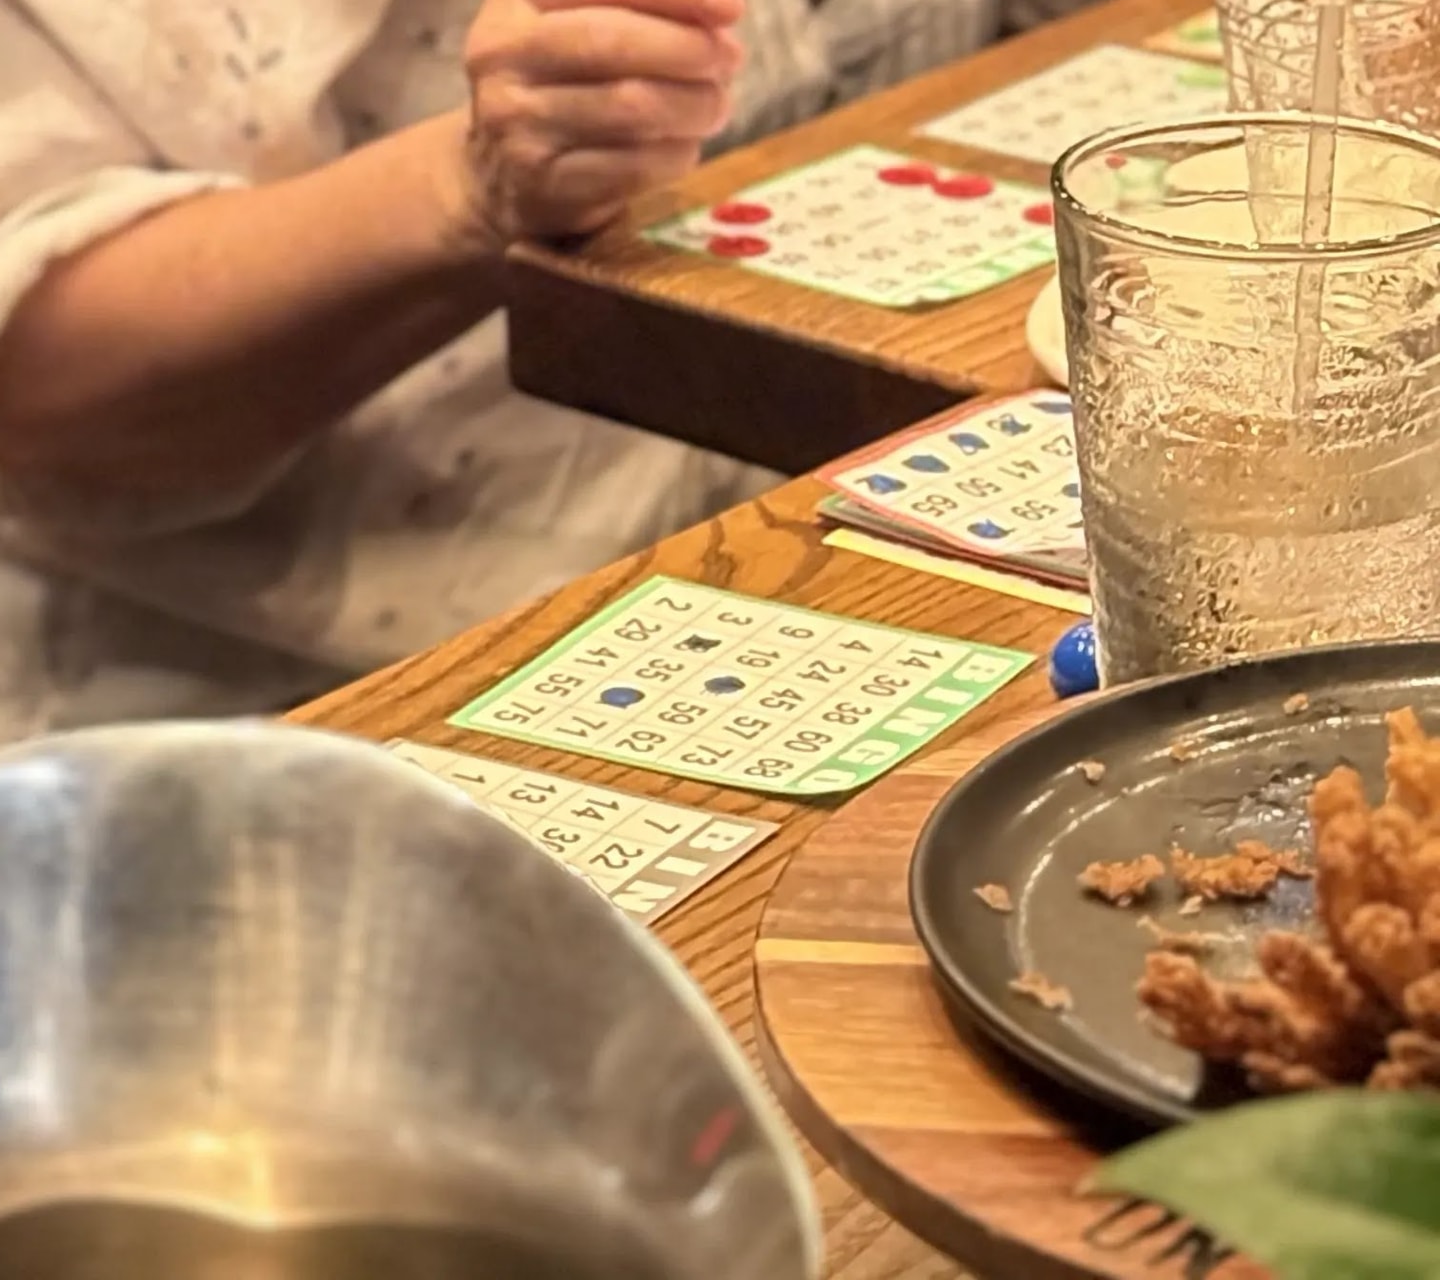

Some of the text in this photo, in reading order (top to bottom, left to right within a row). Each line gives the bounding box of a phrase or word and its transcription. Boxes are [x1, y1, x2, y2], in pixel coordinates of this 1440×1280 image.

[997, 459, 1042, 480] 41
[955, 477, 1002, 498] 50
[910, 494, 958, 518] 65
[1010, 500, 1059, 521] 59
[493, 597, 693, 725] 2 29 41 55 75
[556, 611, 753, 738] 3 35 71
[615, 625, 815, 753] 9 19 59 62
[680, 639, 873, 766] 4 24 45 57 73
[744, 648, 944, 779] 14 30 38 60 68
[452, 771, 487, 787] 1
[508, 781, 558, 805] 13
[569, 798, 621, 822] 14
[588, 817, 682, 870] 7 22
